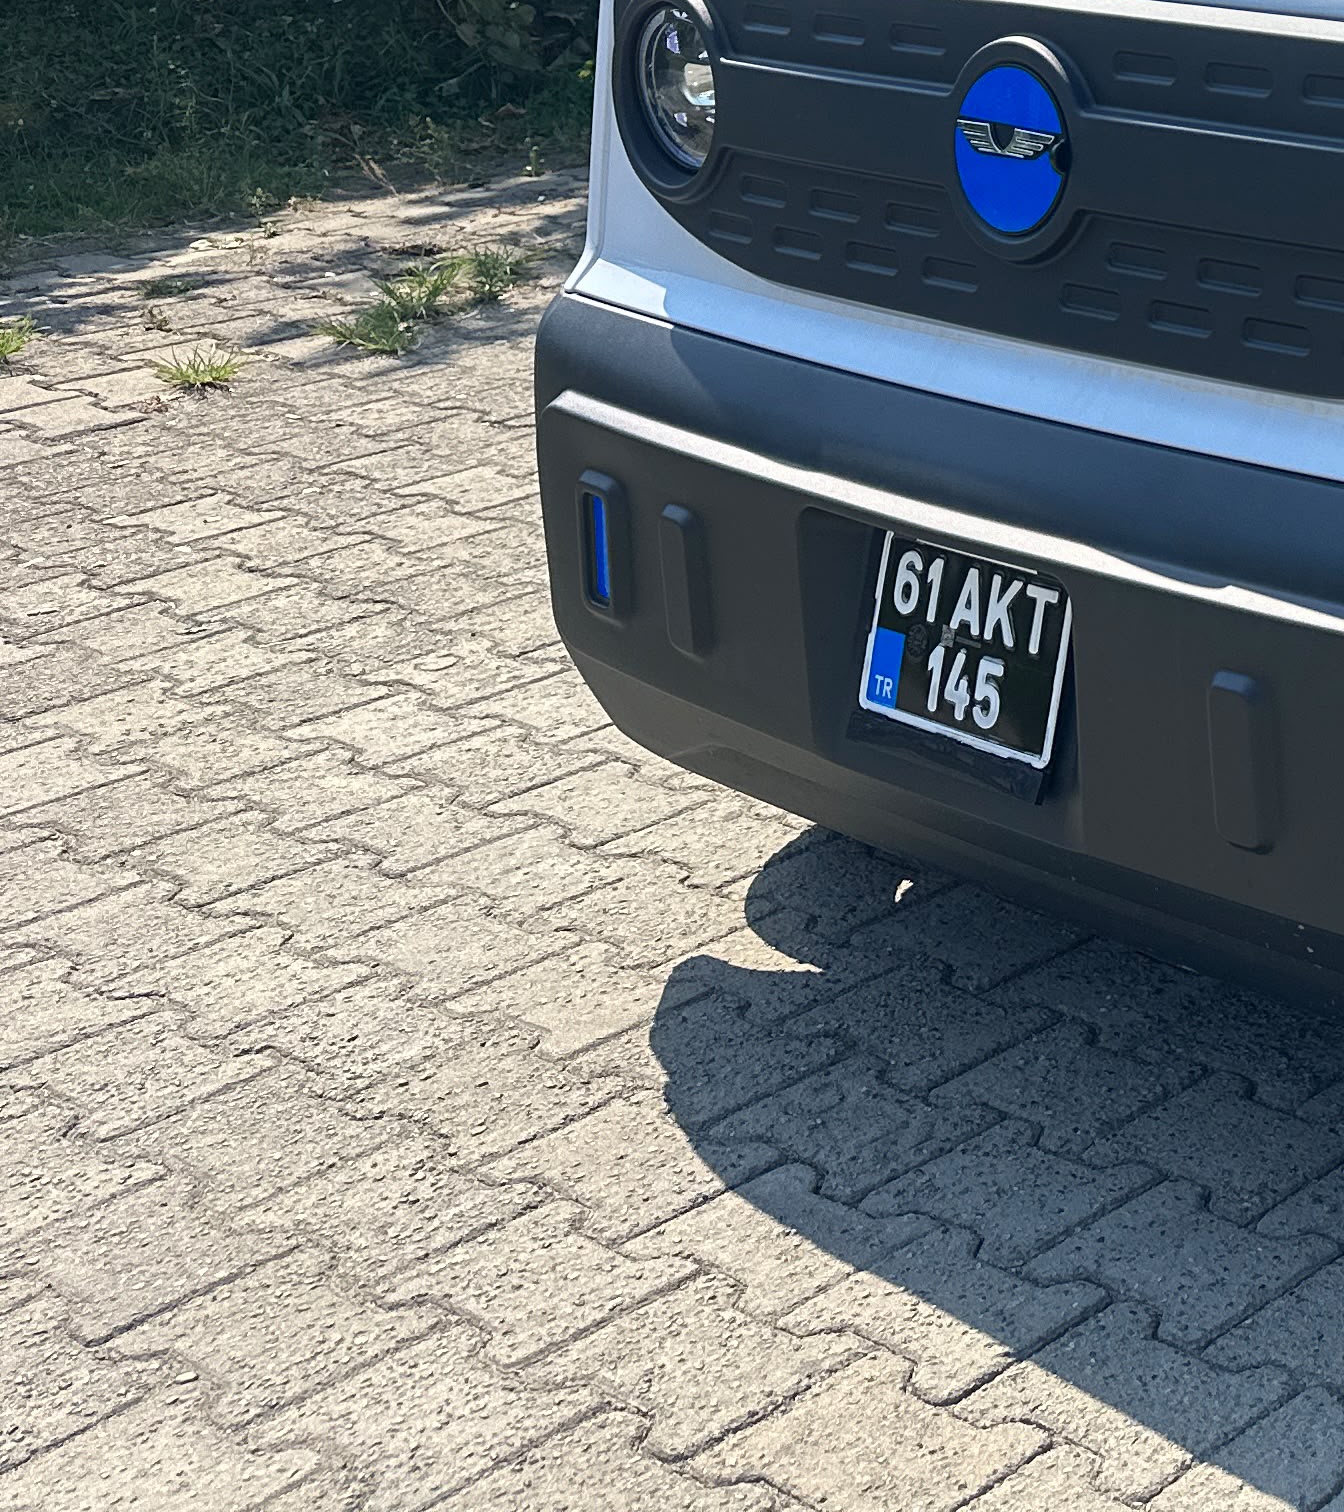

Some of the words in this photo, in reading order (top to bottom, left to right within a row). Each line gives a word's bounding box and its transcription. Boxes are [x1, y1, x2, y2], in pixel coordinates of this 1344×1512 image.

[893, 550, 944, 623] 61
[950, 567, 1060, 655] AKT
[874, 674, 893, 699] TR
[927, 645, 1005, 730] 145
